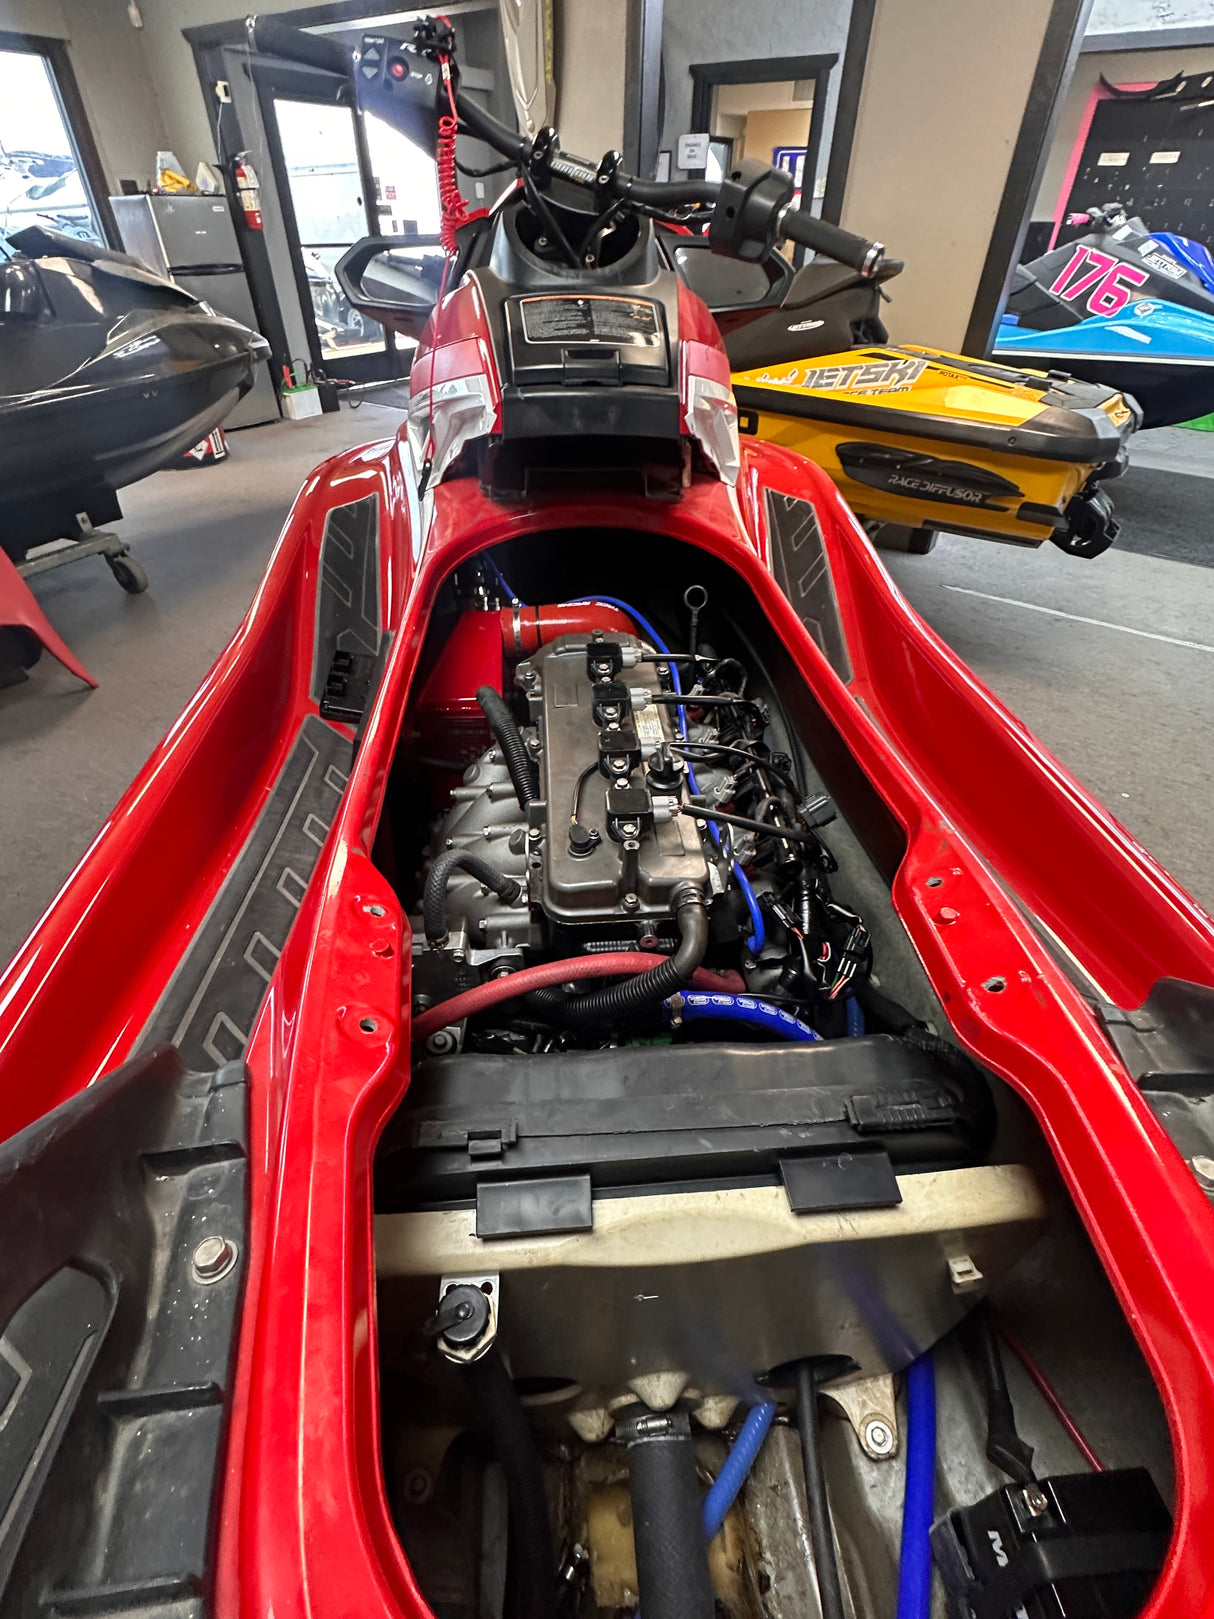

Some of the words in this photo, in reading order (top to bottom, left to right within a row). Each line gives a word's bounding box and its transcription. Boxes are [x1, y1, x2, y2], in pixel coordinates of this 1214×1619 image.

[1049, 244, 1150, 318] 176
[801, 359, 929, 390] JETSKI
[870, 385, 910, 396] TEAM
[888, 474, 921, 489] RACE
[919, 480, 983, 504] DIFFUSOR
